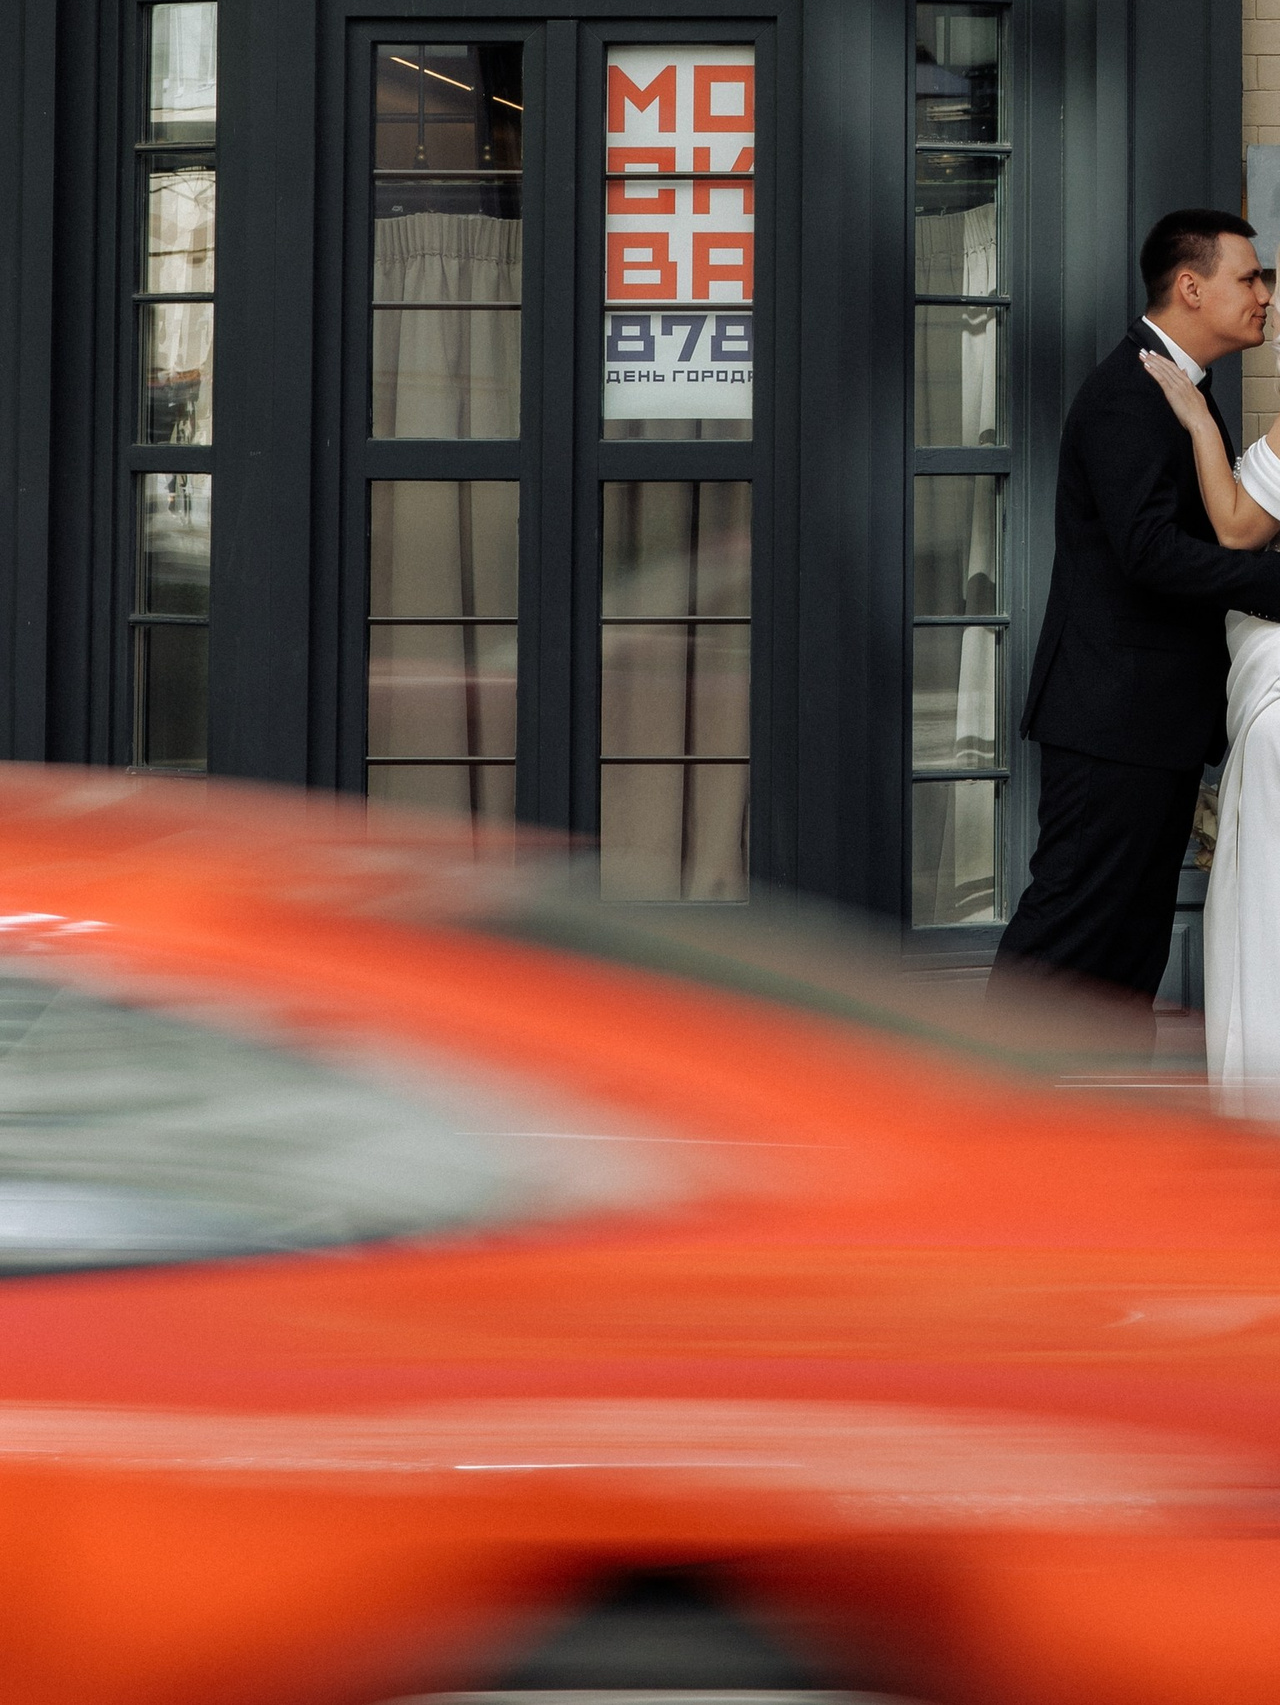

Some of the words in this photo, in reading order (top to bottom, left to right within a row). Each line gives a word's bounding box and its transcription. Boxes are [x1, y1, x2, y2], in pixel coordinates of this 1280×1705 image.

[608, 65, 755, 133] МО
[606, 314, 754, 362] 878
[606, 370, 665, 384] ДЕНЬ
